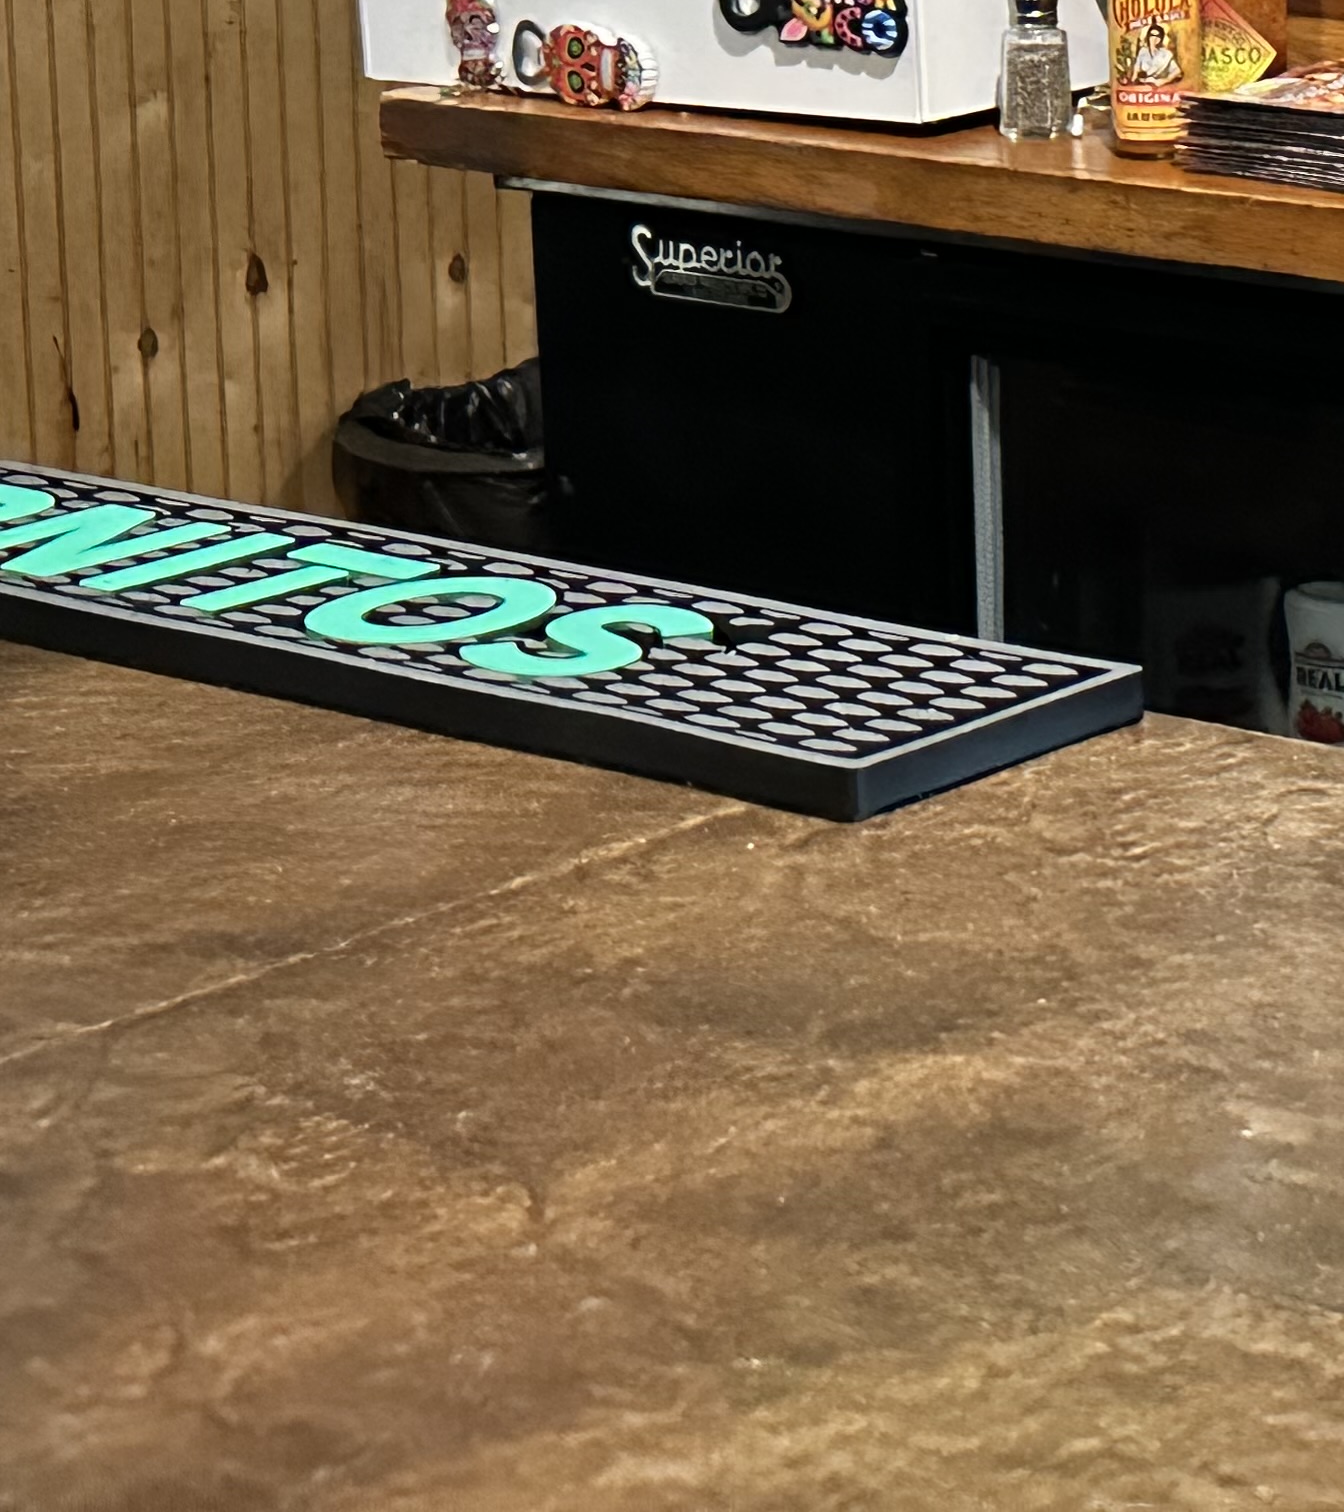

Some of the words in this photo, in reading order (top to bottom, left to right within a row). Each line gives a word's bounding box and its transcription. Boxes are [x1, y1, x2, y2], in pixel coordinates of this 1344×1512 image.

[1200, 46, 1261, 65] ASCO
[1118, 91, 1182, 104] ORIGINA
[632, 224, 784, 287] Superior
[0, 485, 714, 677] NITOS
